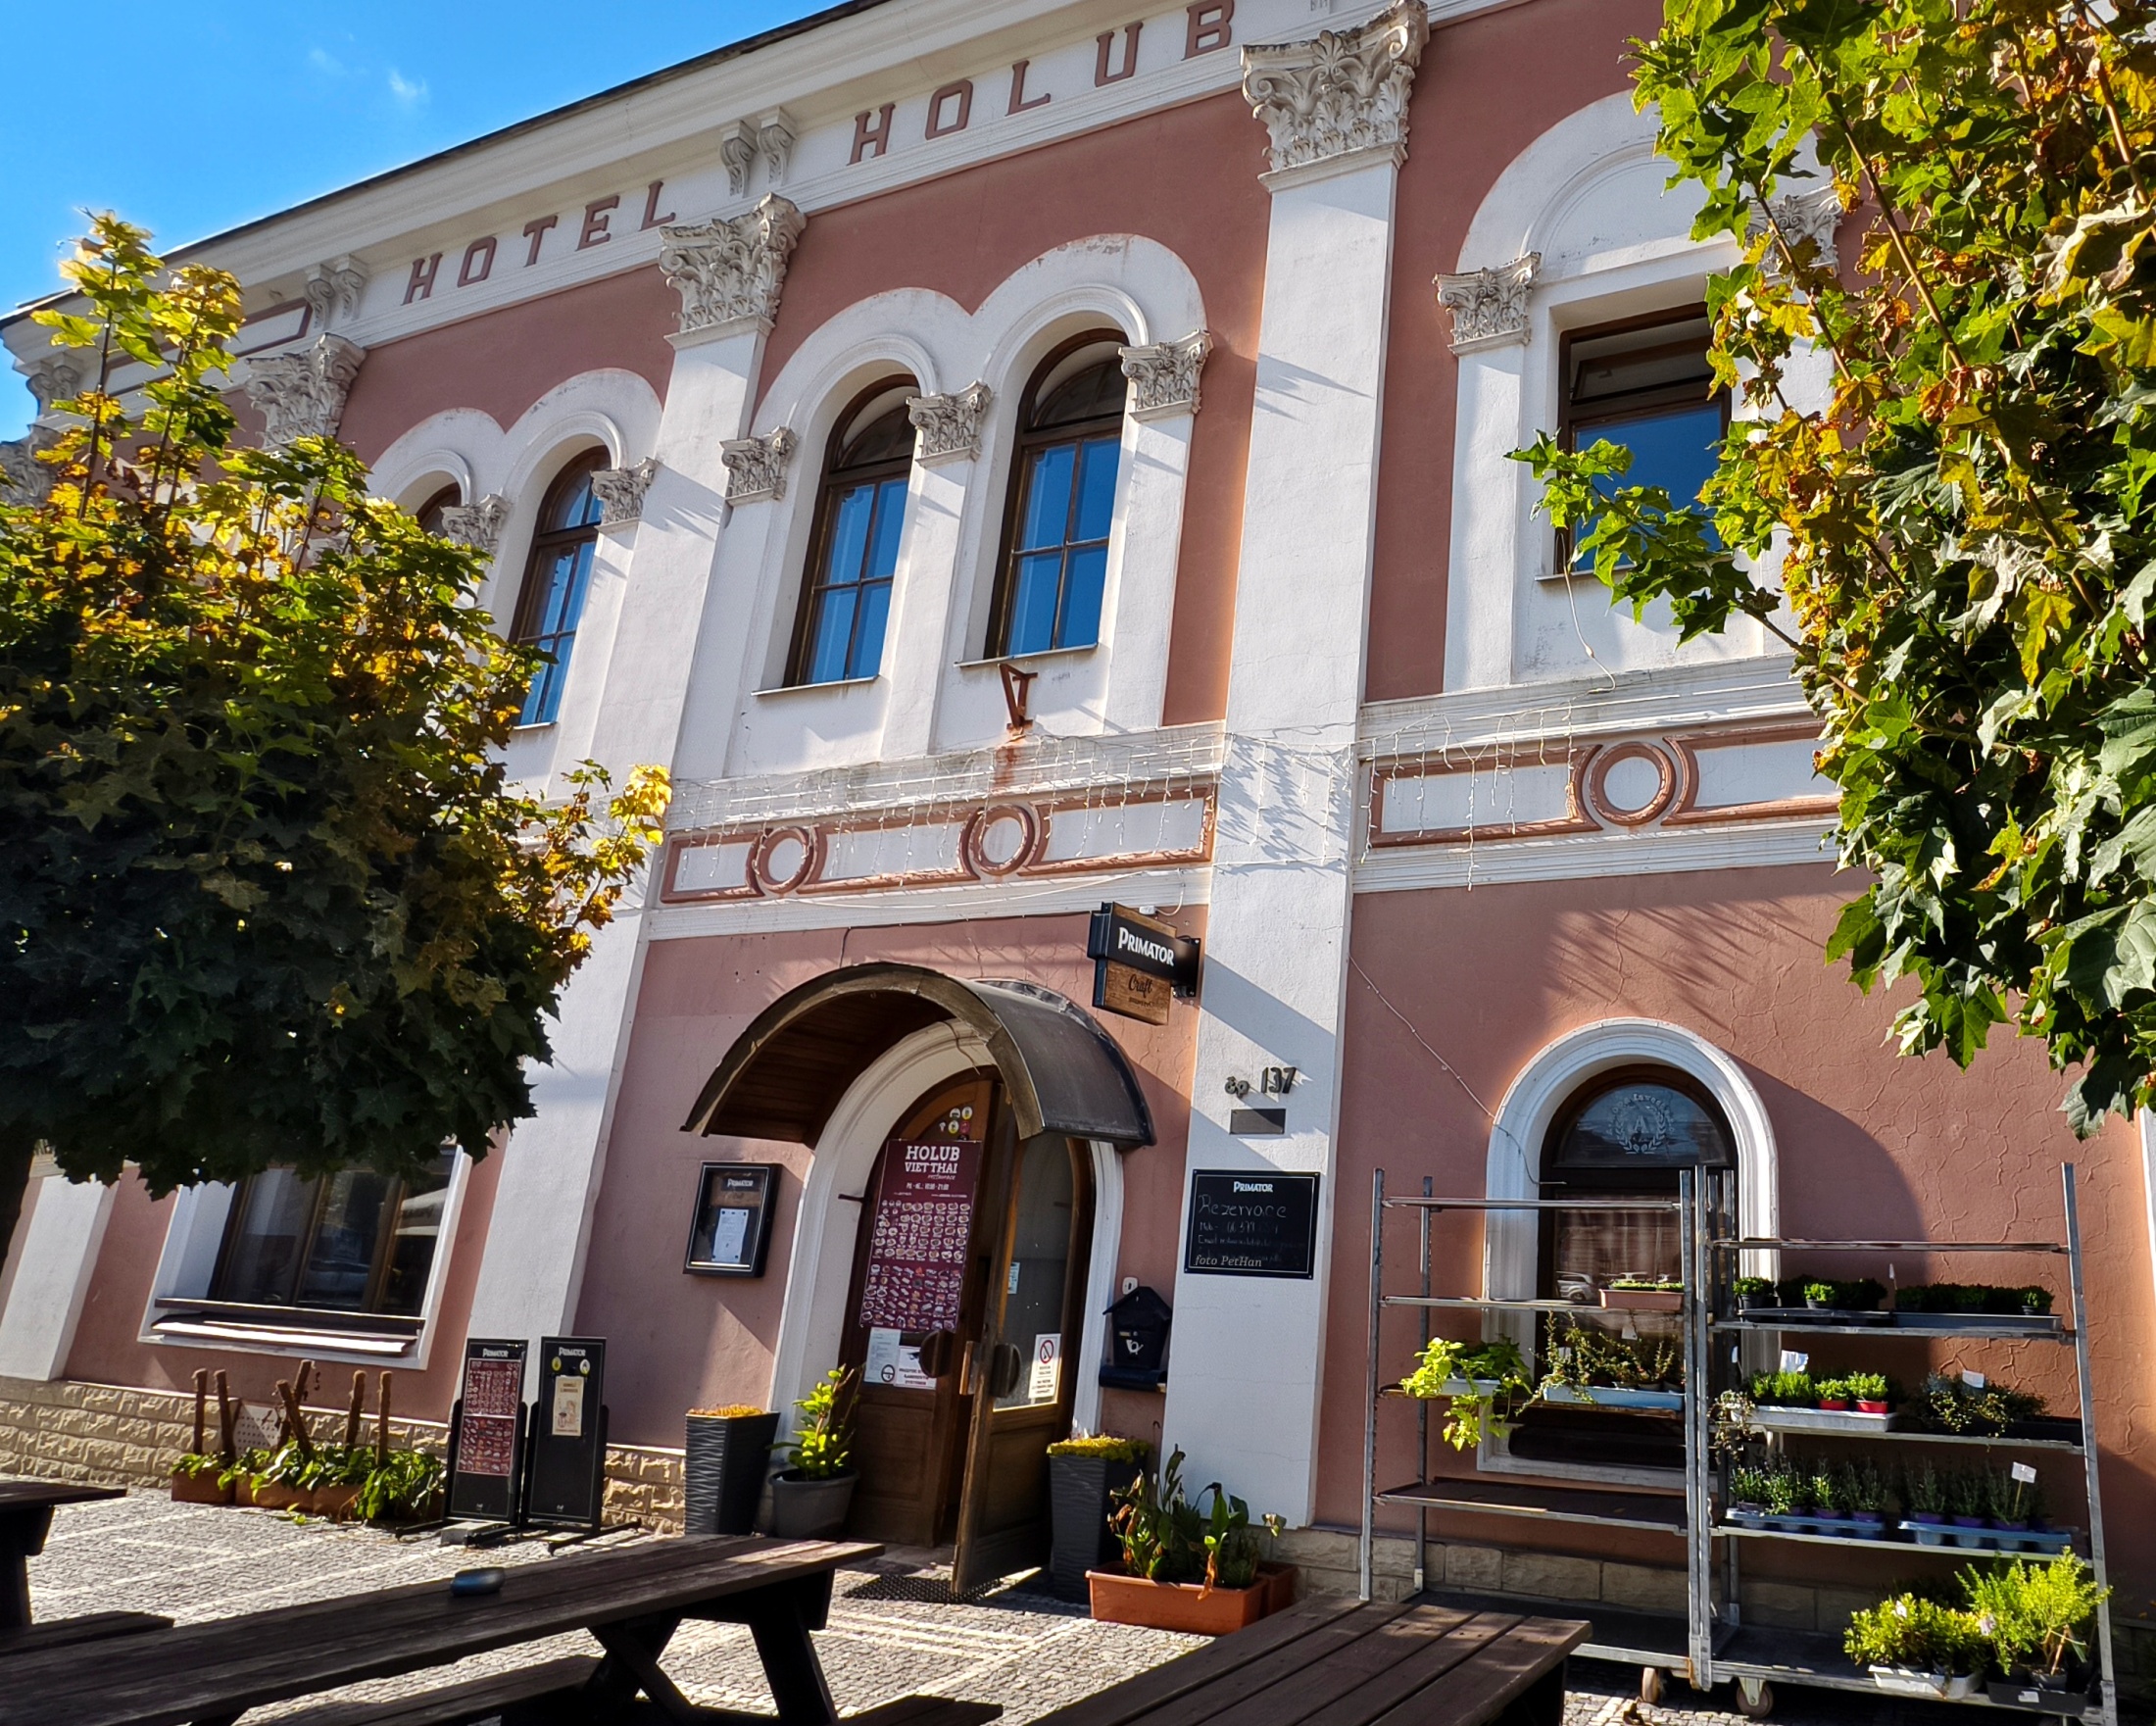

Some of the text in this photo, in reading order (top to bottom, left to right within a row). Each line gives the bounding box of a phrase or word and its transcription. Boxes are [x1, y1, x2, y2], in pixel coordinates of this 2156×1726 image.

[401, 0, 1235, 306] HOTEL HOLUB
[1117, 926, 1175, 966] PRIMATOR
[1128, 973, 1153, 998] Craft
[1260, 1066, 1298, 1094] 137
[905, 1146, 960, 1161] HOLUB
[1233, 1181, 1273, 1193] PRIMATOR
